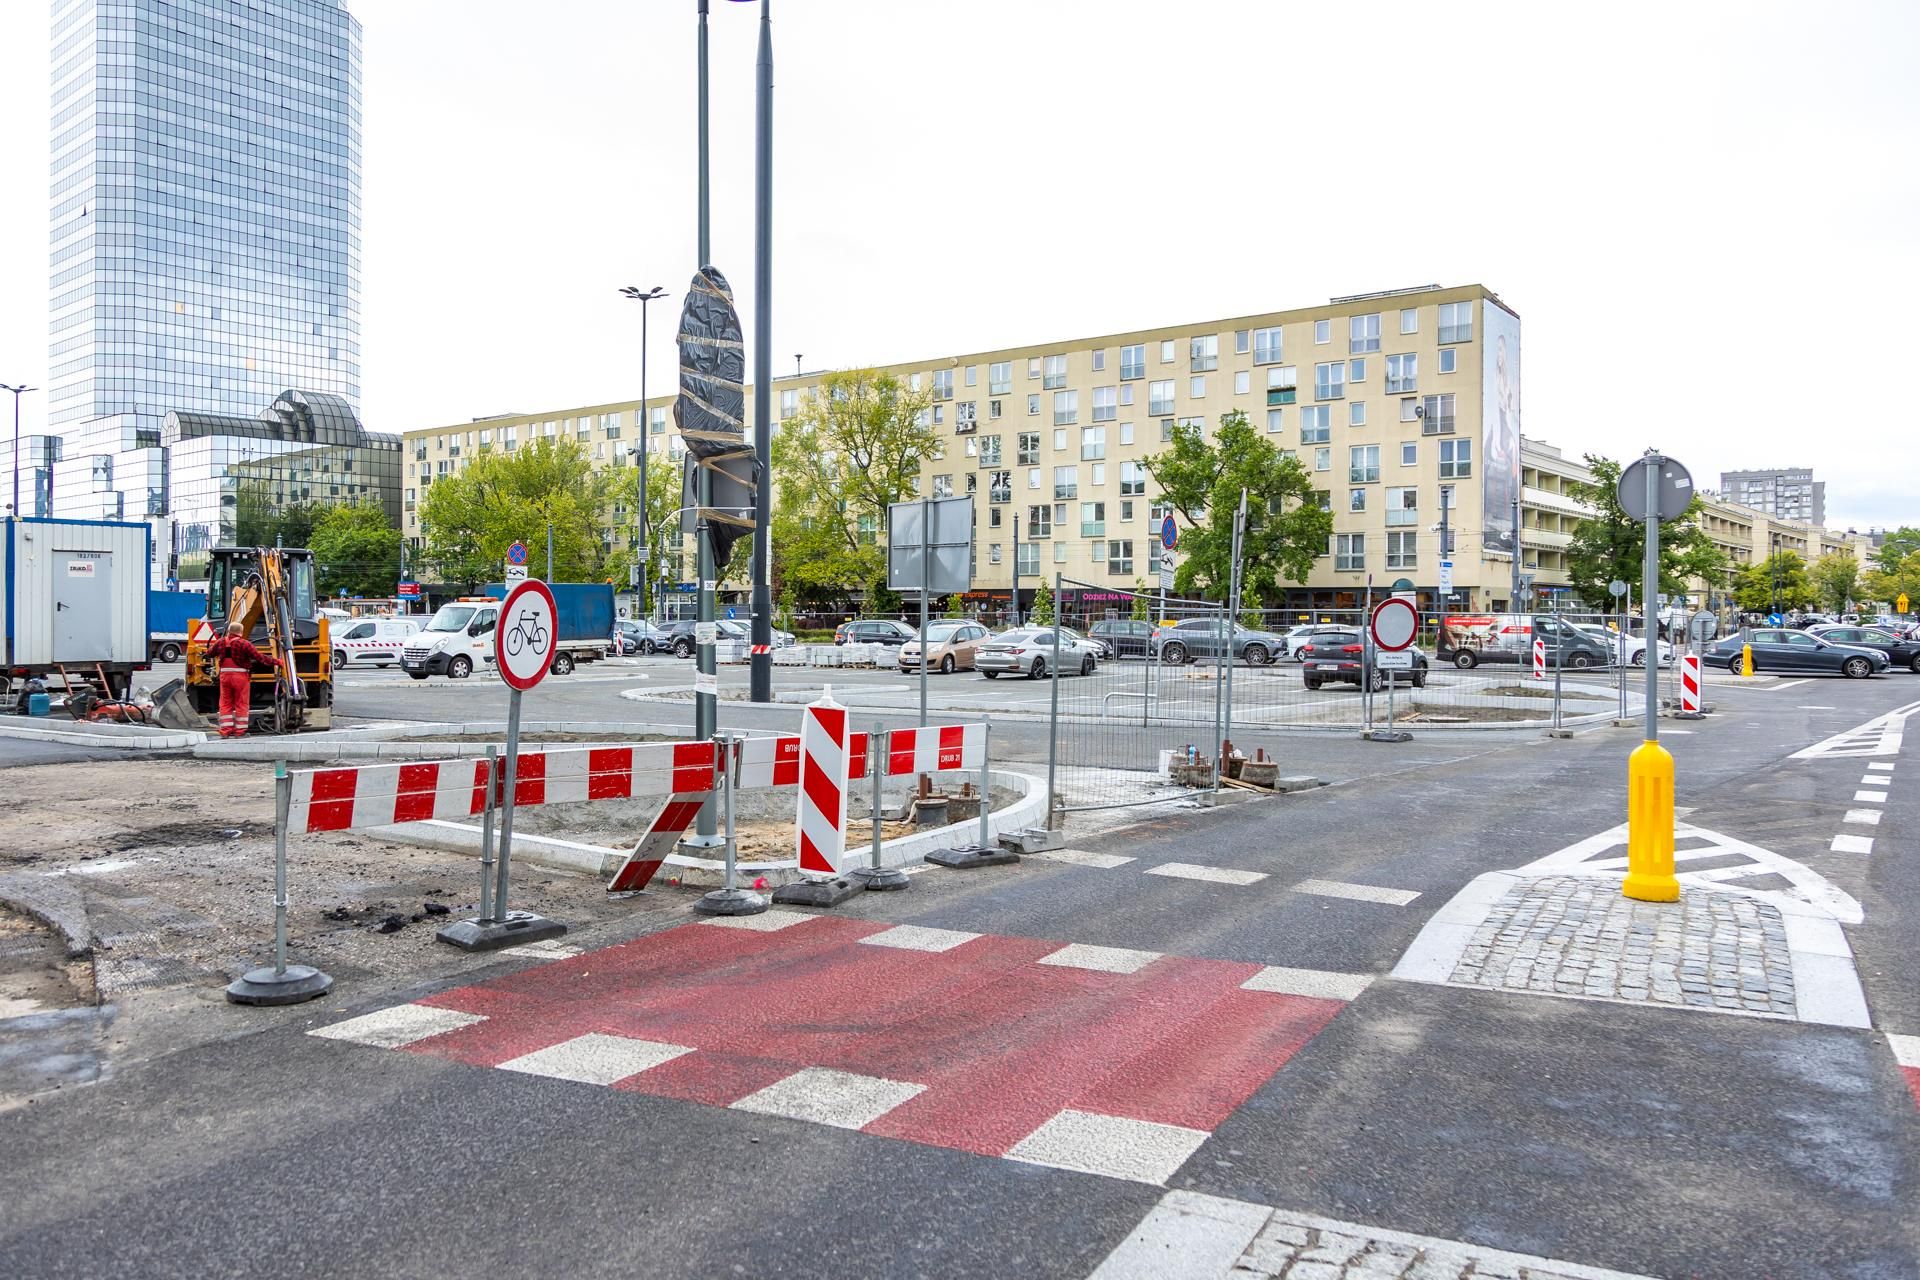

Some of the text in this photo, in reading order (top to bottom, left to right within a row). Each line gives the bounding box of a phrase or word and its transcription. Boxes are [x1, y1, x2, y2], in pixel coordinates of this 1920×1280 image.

[1108, 593, 1119, 601] NA
[940, 753, 961, 763] DRUB 21
